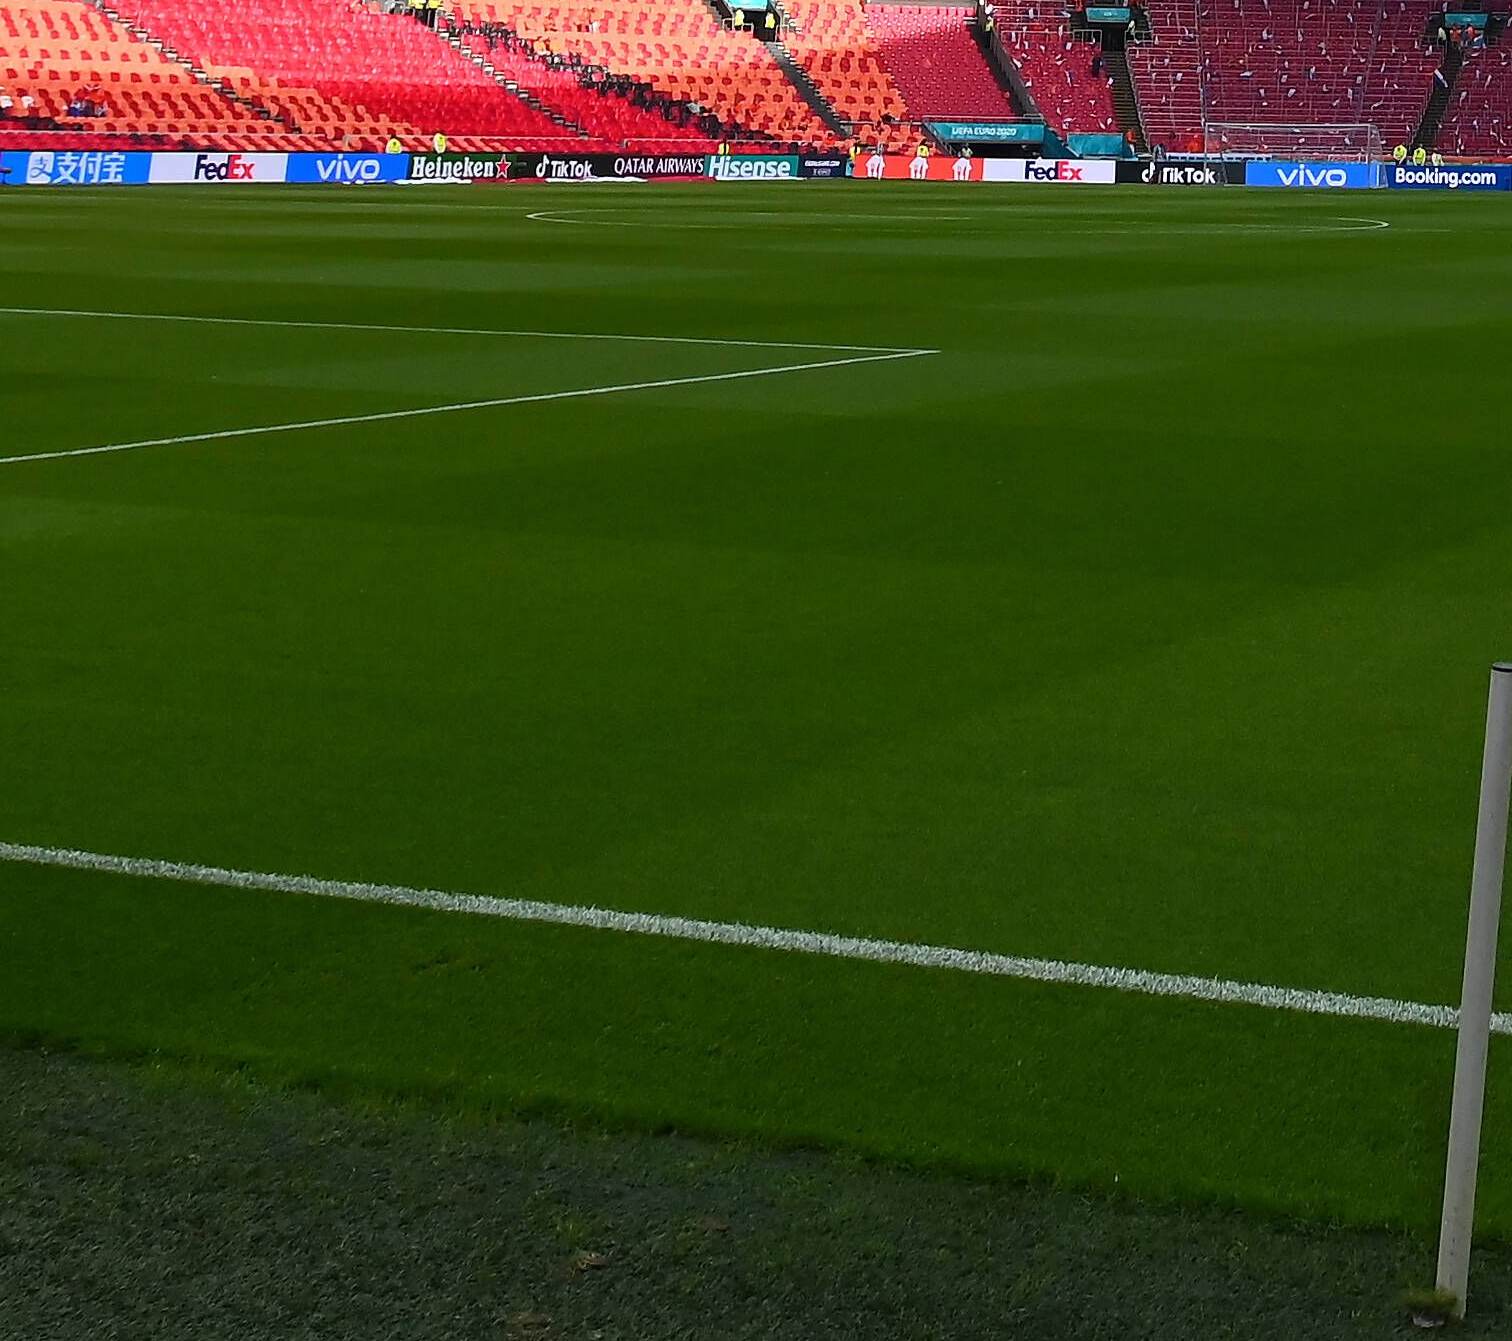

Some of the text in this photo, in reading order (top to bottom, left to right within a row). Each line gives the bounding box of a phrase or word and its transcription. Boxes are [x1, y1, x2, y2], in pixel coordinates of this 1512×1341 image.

[194, 154, 256, 179] FedEx
[315, 153, 381, 180] vivo
[411, 156, 495, 178] Heineken
[551, 160, 593, 177] TikTok
[614, 158, 705, 175] QATAR AIRWAYS
[708, 156, 791, 178] Hisense
[1024, 160, 1083, 180] FedEx
[1162, 167, 1216, 183] TikTok
[1277, 164, 1348, 186] vivo
[1395, 168, 1496, 188] Booking.com
